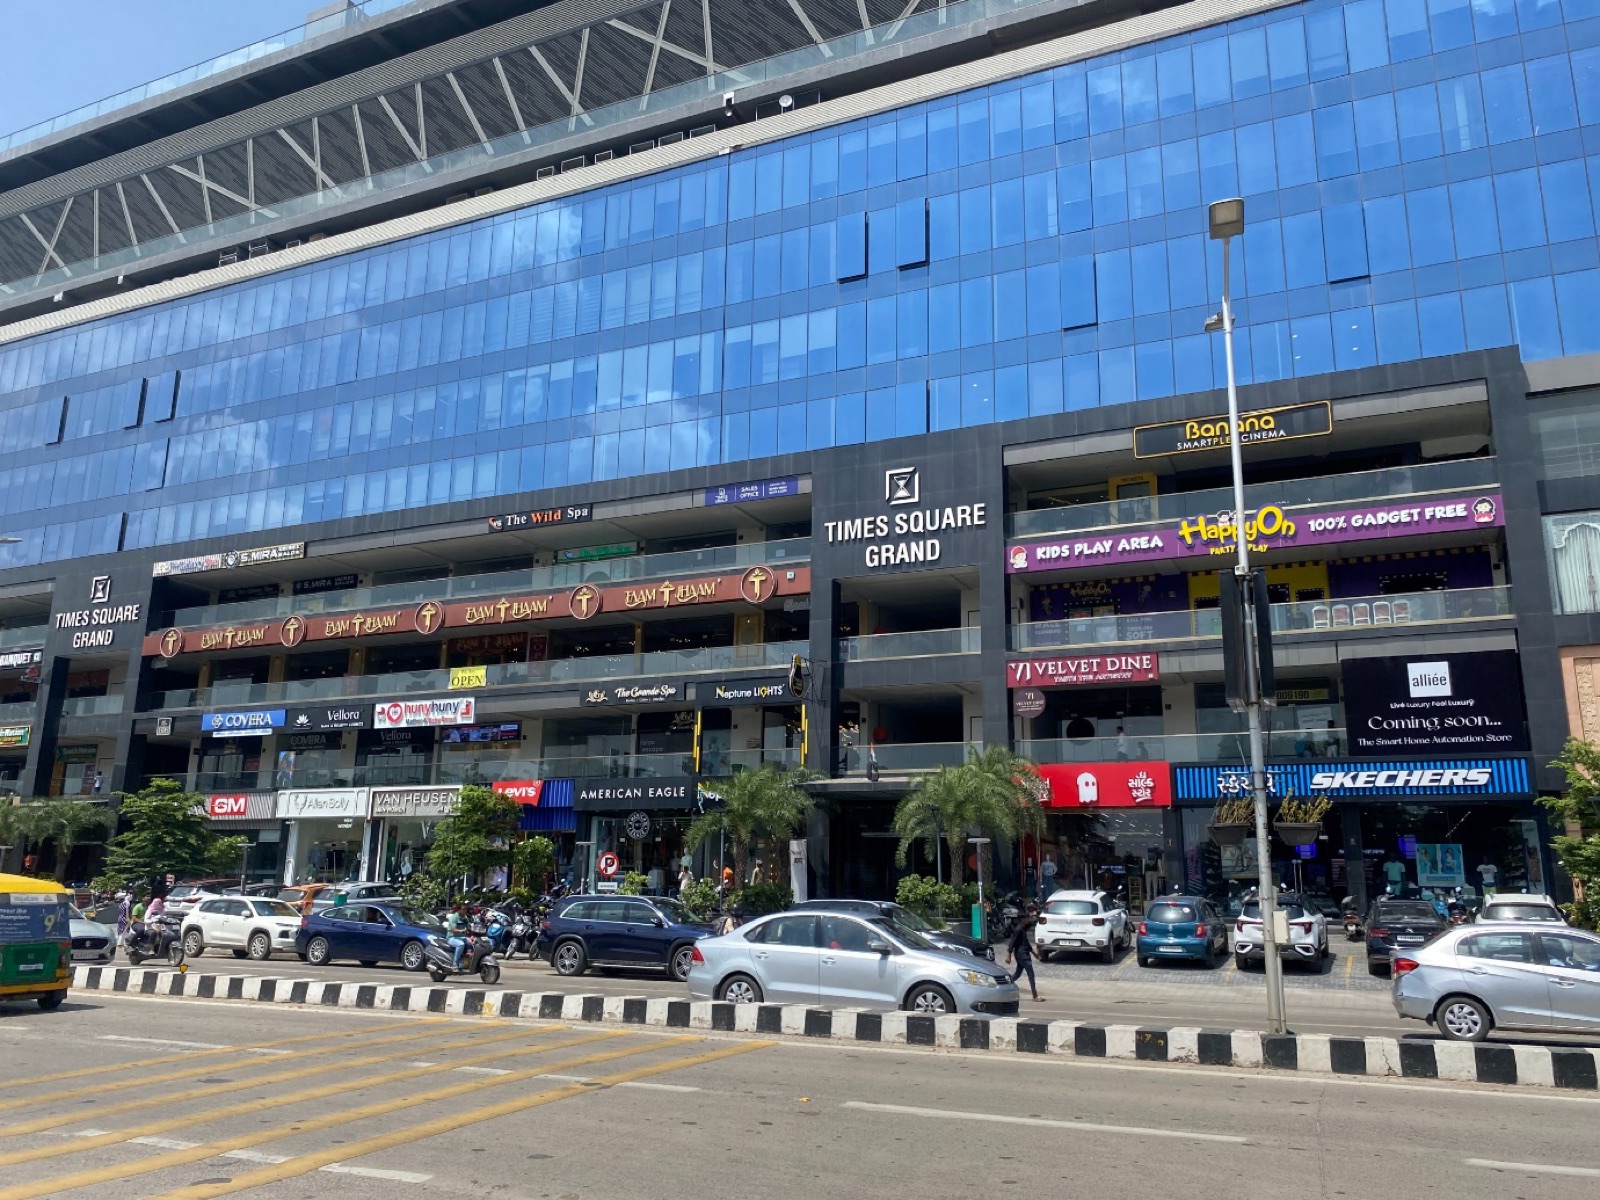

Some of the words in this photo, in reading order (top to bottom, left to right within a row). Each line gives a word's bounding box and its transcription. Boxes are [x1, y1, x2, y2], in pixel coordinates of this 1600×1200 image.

[1176, 436, 1232, 451] SMARTPLE
[1241, 429, 1287, 442] CINEMA
[741, 485, 758, 493] SALES
[505, 515, 527, 526] The
[531, 509, 562, 524] Wild
[567, 507, 589, 519] Spa
[824, 515, 889, 543] TIMES
[894, 503, 987, 534] SQUARE
[1307, 515, 1348, 533] 100%
[1351, 508, 1421, 528] GADGET
[1424, 503, 1468, 521] FREE
[865, 539, 941, 568] GRAND
[1036, 544, 1070, 561] KIDS
[1073, 540, 1112, 557] PLAY
[1117, 535, 1164, 552] AREA
[1209, 545, 1236, 555] PARTY
[1247, 543, 1270, 553] PLAY
[56, 610, 89, 628] TIMES
[92, 604, 140, 625] SQUARE
[73, 629, 114, 648] GRAND
[1126, 631, 1154, 640] SOFT
[1034, 659, 1101, 676] VELVET
[1106, 655, 1152, 671] DINE
[451, 674, 483, 687] OPEN
[1412, 673, 1447, 688] alliée
[614, 687, 630, 698] The
[660, 685, 677, 697] Spa
[715, 686, 752, 699] Neptune
[754, 685, 784, 697] LIGHTS
[404, 700, 460, 714] hunyhuny
[1448, 699, 1475, 707] Luxury
[225, 712, 273, 728] COVERA
[327, 708, 360, 721] Vellora
[1368, 715, 1440, 731] Coming
[1444, 714, 1502, 727] soon...
[1357, 737, 1375, 746] The
[1376, 737, 1402, 746] Smart
[1404, 736, 1431, 745] Home
[1431, 735, 1484, 744] Automation
[1486, 733, 1513, 742] Store
[1309, 768, 1492, 789] SKECHERS
[376, 792, 400, 805] VAN
[404, 791, 457, 804] HEUSEN
[580, 787, 642, 800] AMERICAN
[648, 786, 685, 799] EAGLE
[213, 797, 246, 813] GM
[307, 797, 330, 810] Allen
